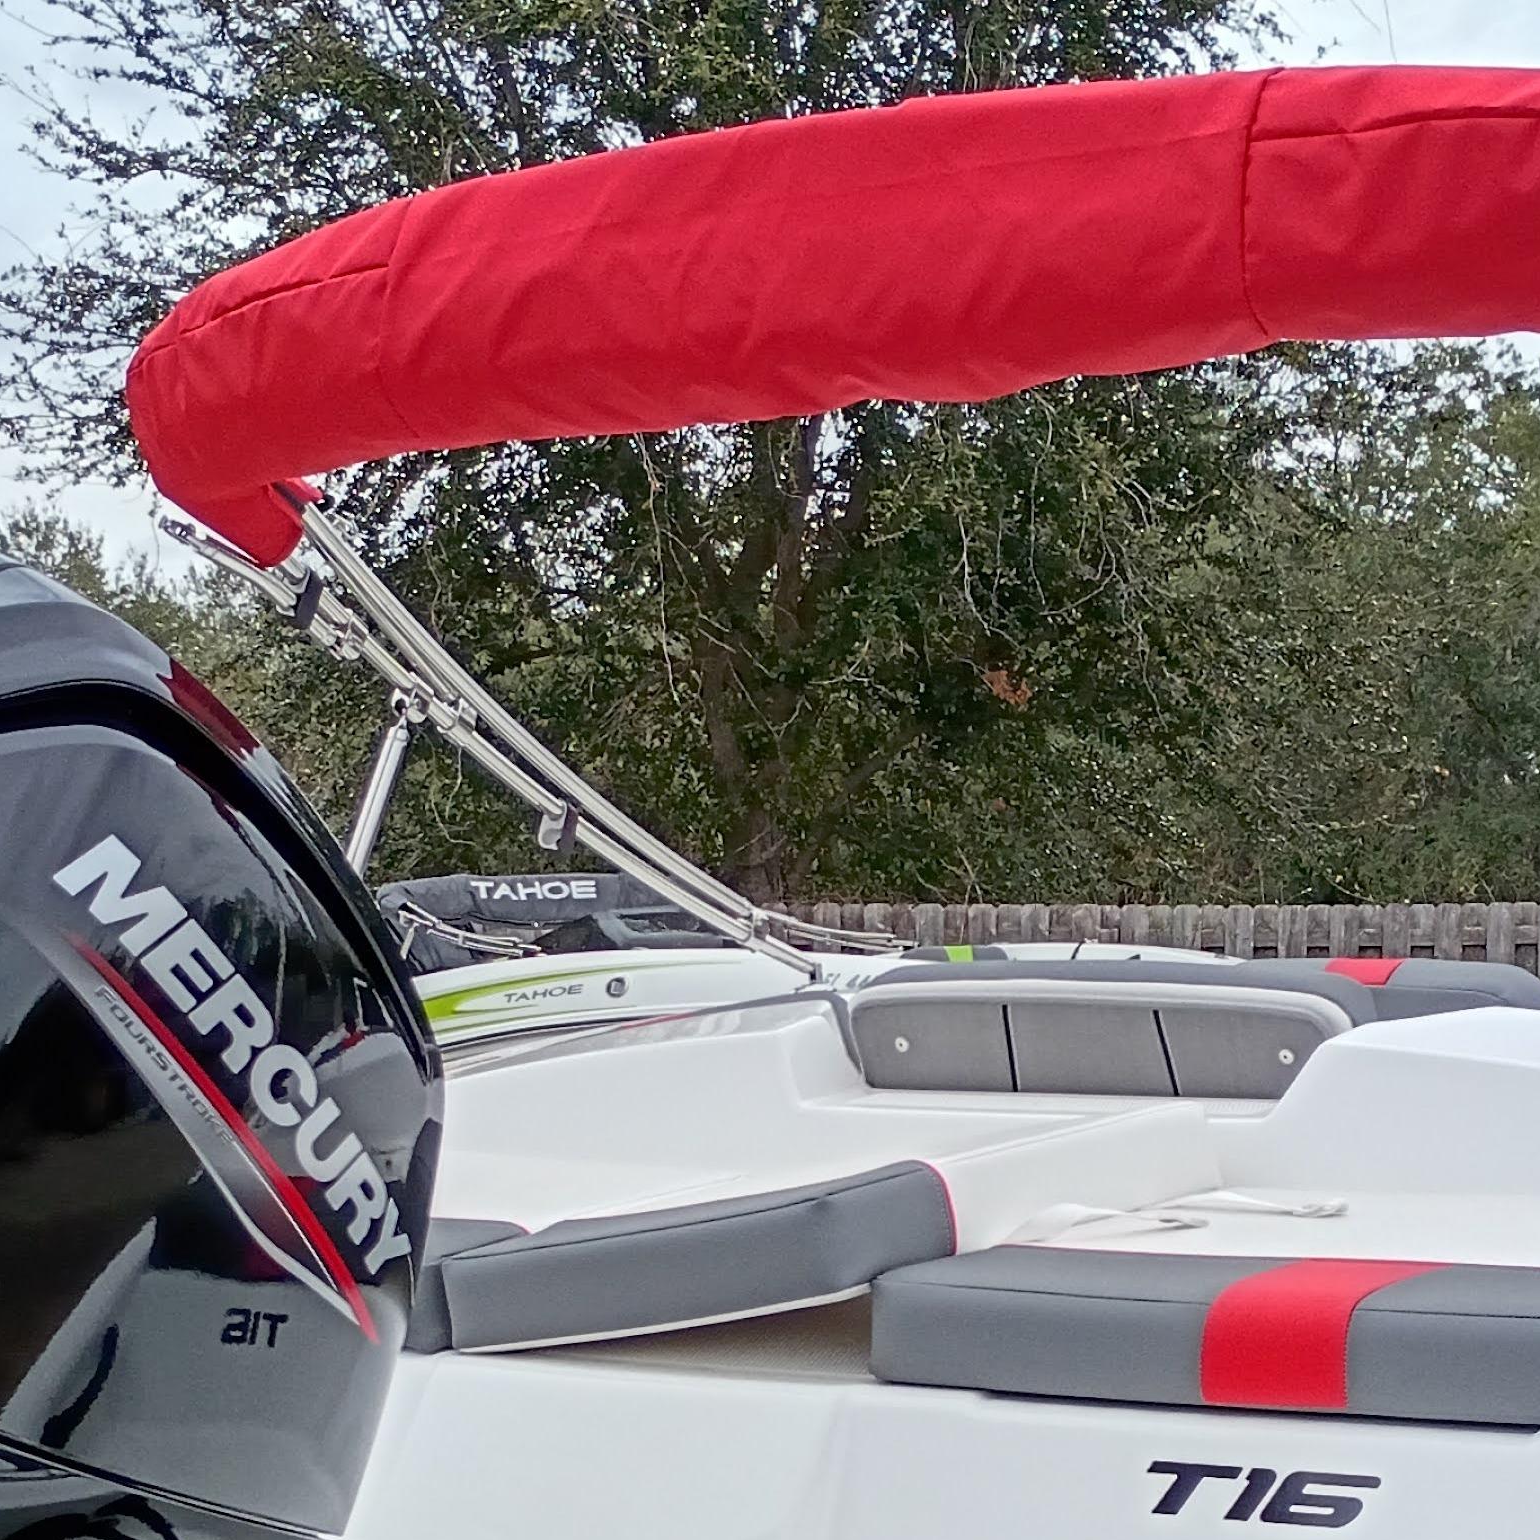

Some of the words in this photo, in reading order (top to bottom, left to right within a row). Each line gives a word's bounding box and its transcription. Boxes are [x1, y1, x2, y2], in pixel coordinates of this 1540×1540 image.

[471, 879, 598, 901] TAHOE
[504, 983, 584, 1004] TAHOE
[53, 834, 414, 1276] MERCURY
[94, 983, 234, 1143] FOURSTROKE
[1147, 1460, 1381, 1528] T16
